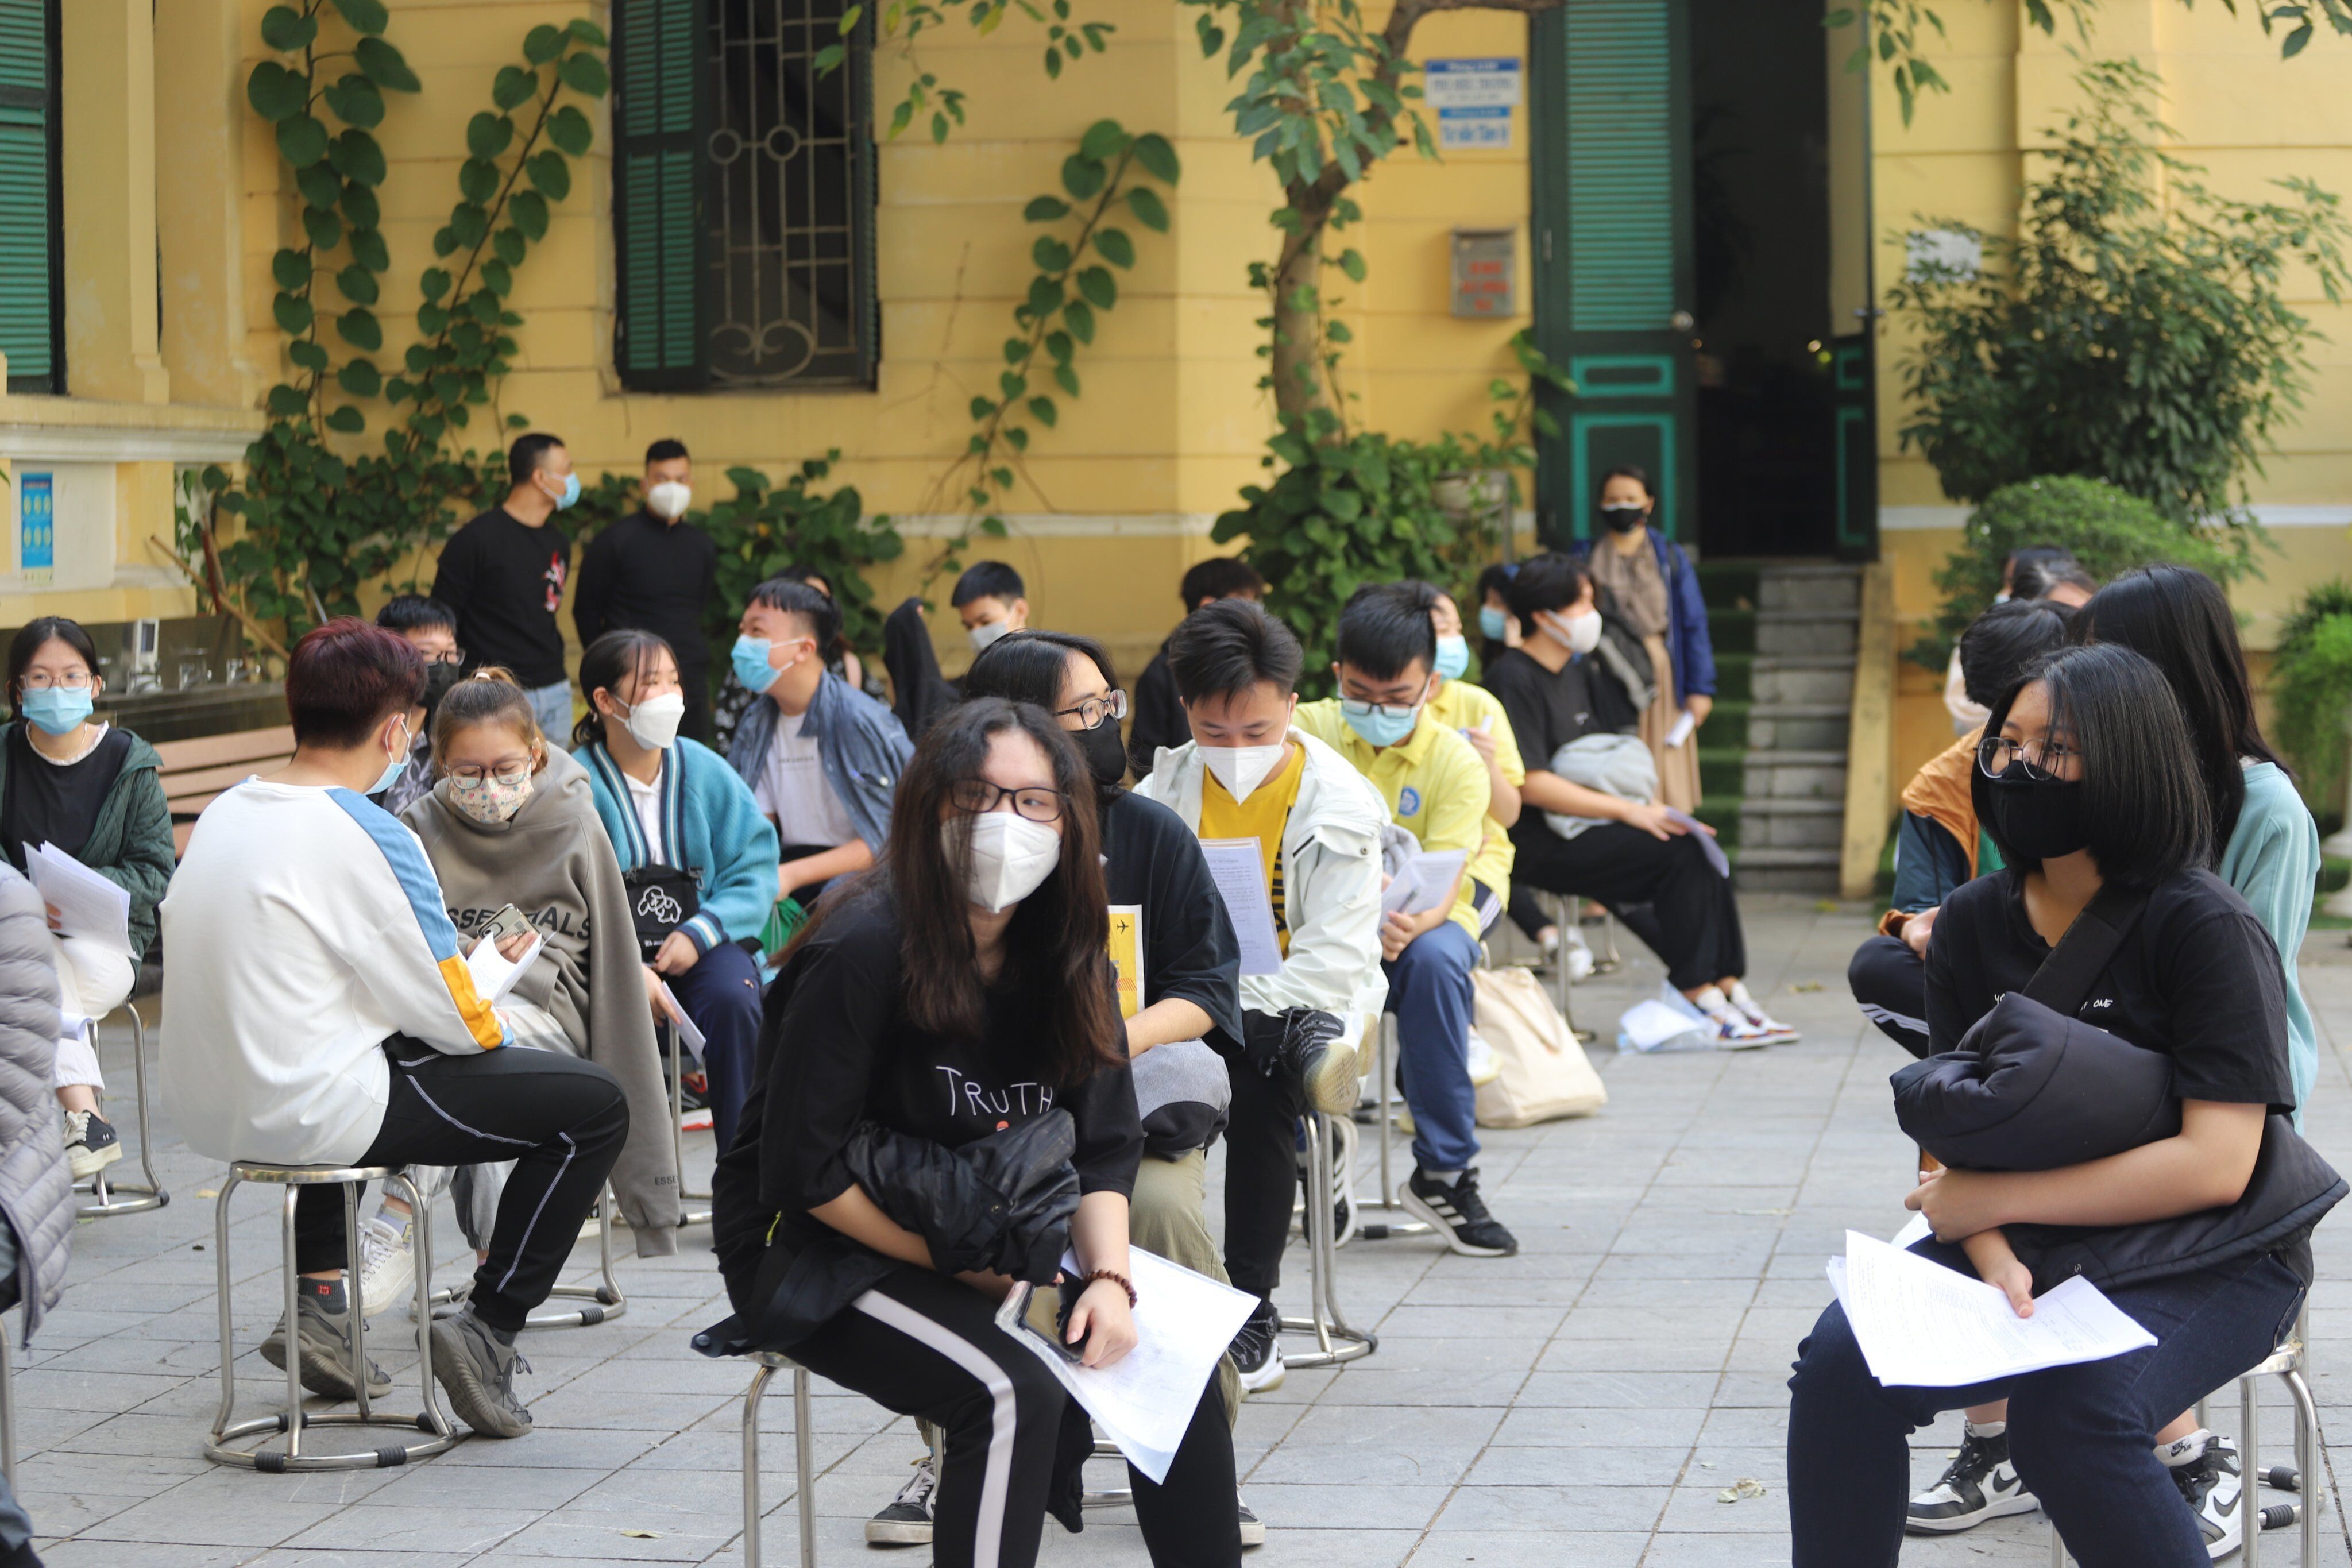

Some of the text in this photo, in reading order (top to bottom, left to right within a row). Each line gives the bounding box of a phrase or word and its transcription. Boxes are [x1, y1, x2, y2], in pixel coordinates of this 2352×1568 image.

[447, 906, 590, 940] SSEIALS
[935, 1065, 1053, 1117] TRUTH
[2172, 1440, 2184, 1450] NIKE
